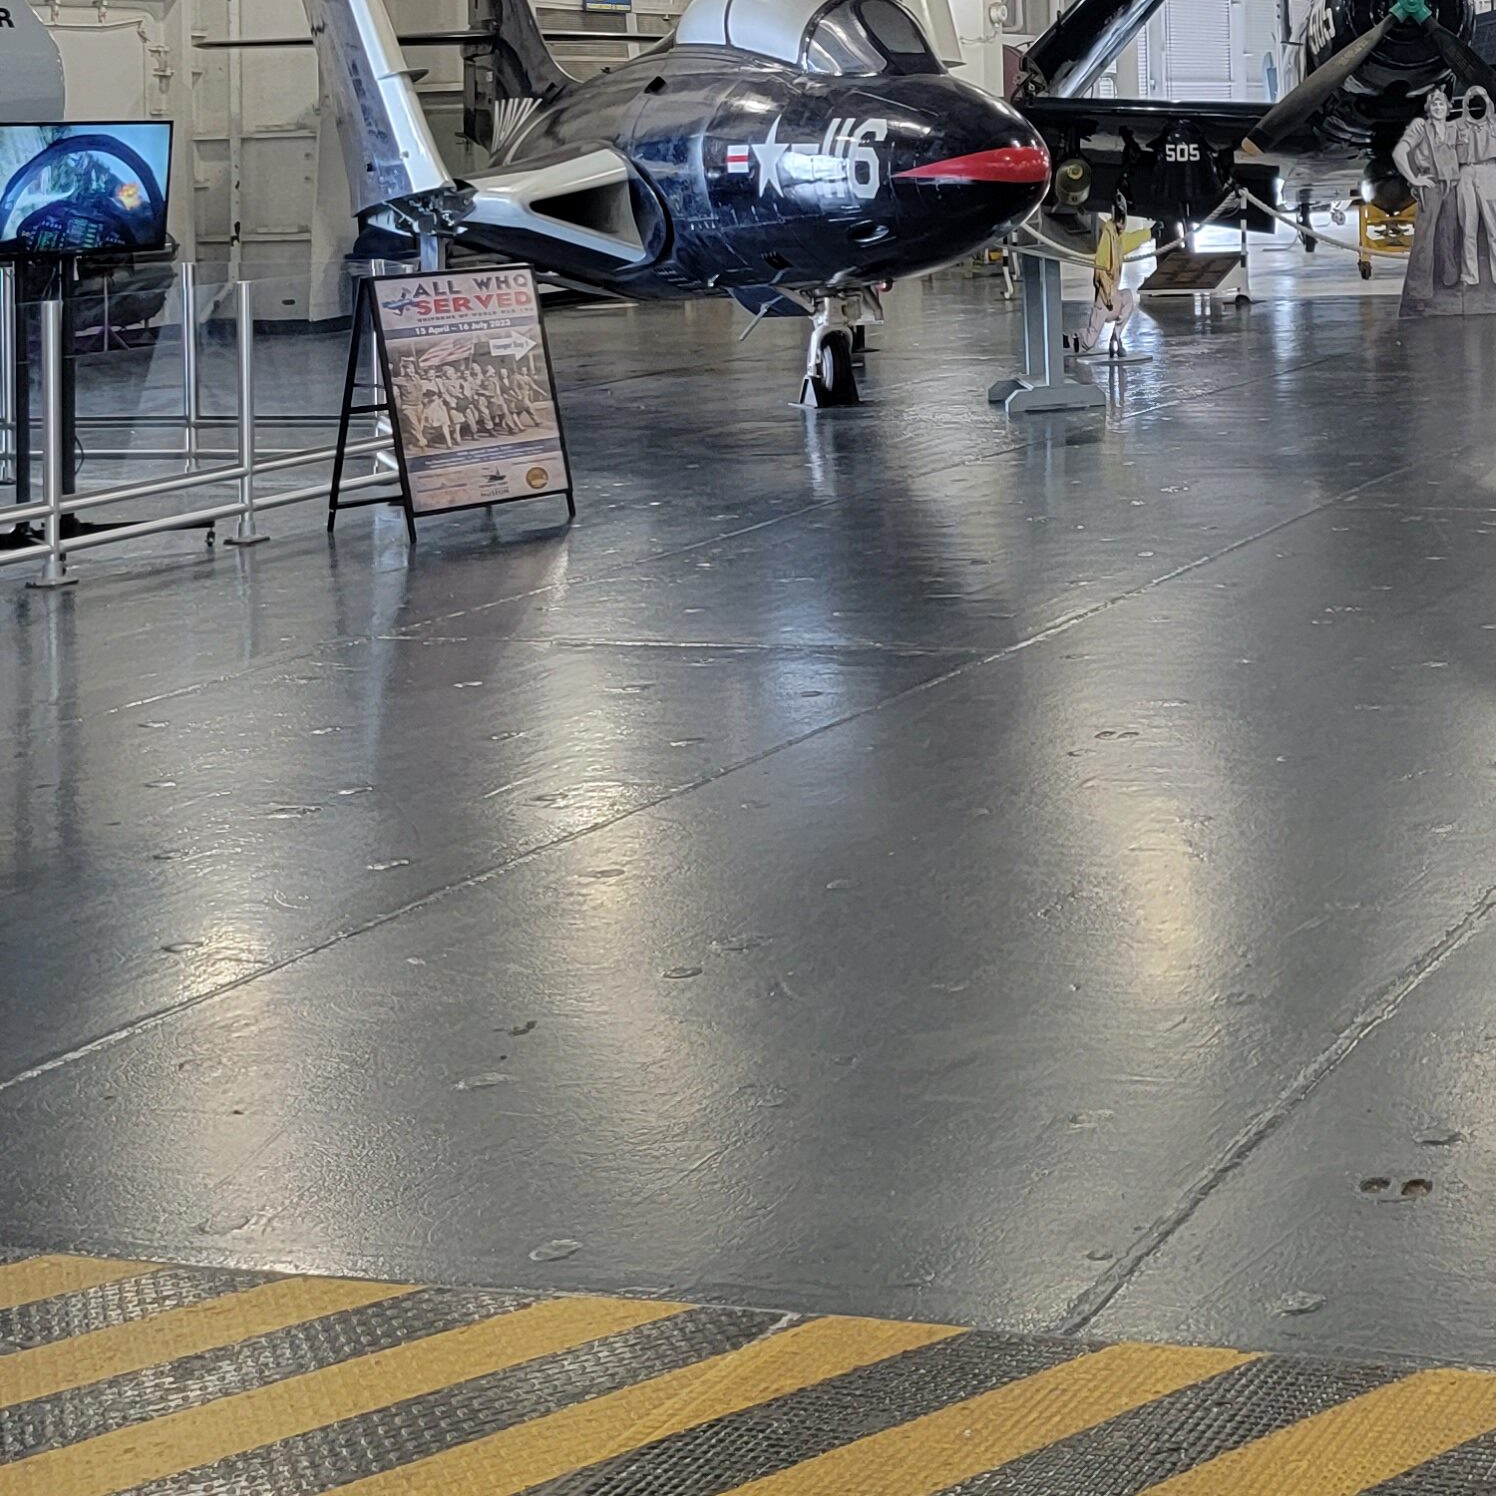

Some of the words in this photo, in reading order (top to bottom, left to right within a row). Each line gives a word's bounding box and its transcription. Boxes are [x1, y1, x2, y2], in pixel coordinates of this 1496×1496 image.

[1165, 143, 1200, 162] 505
[413, 279, 461, 297] ALL
[472, 273, 529, 291] WHO
[416, 291, 532, 315] SERVED
[428, 326, 449, 335] April
[471, 321, 488, 329] July
